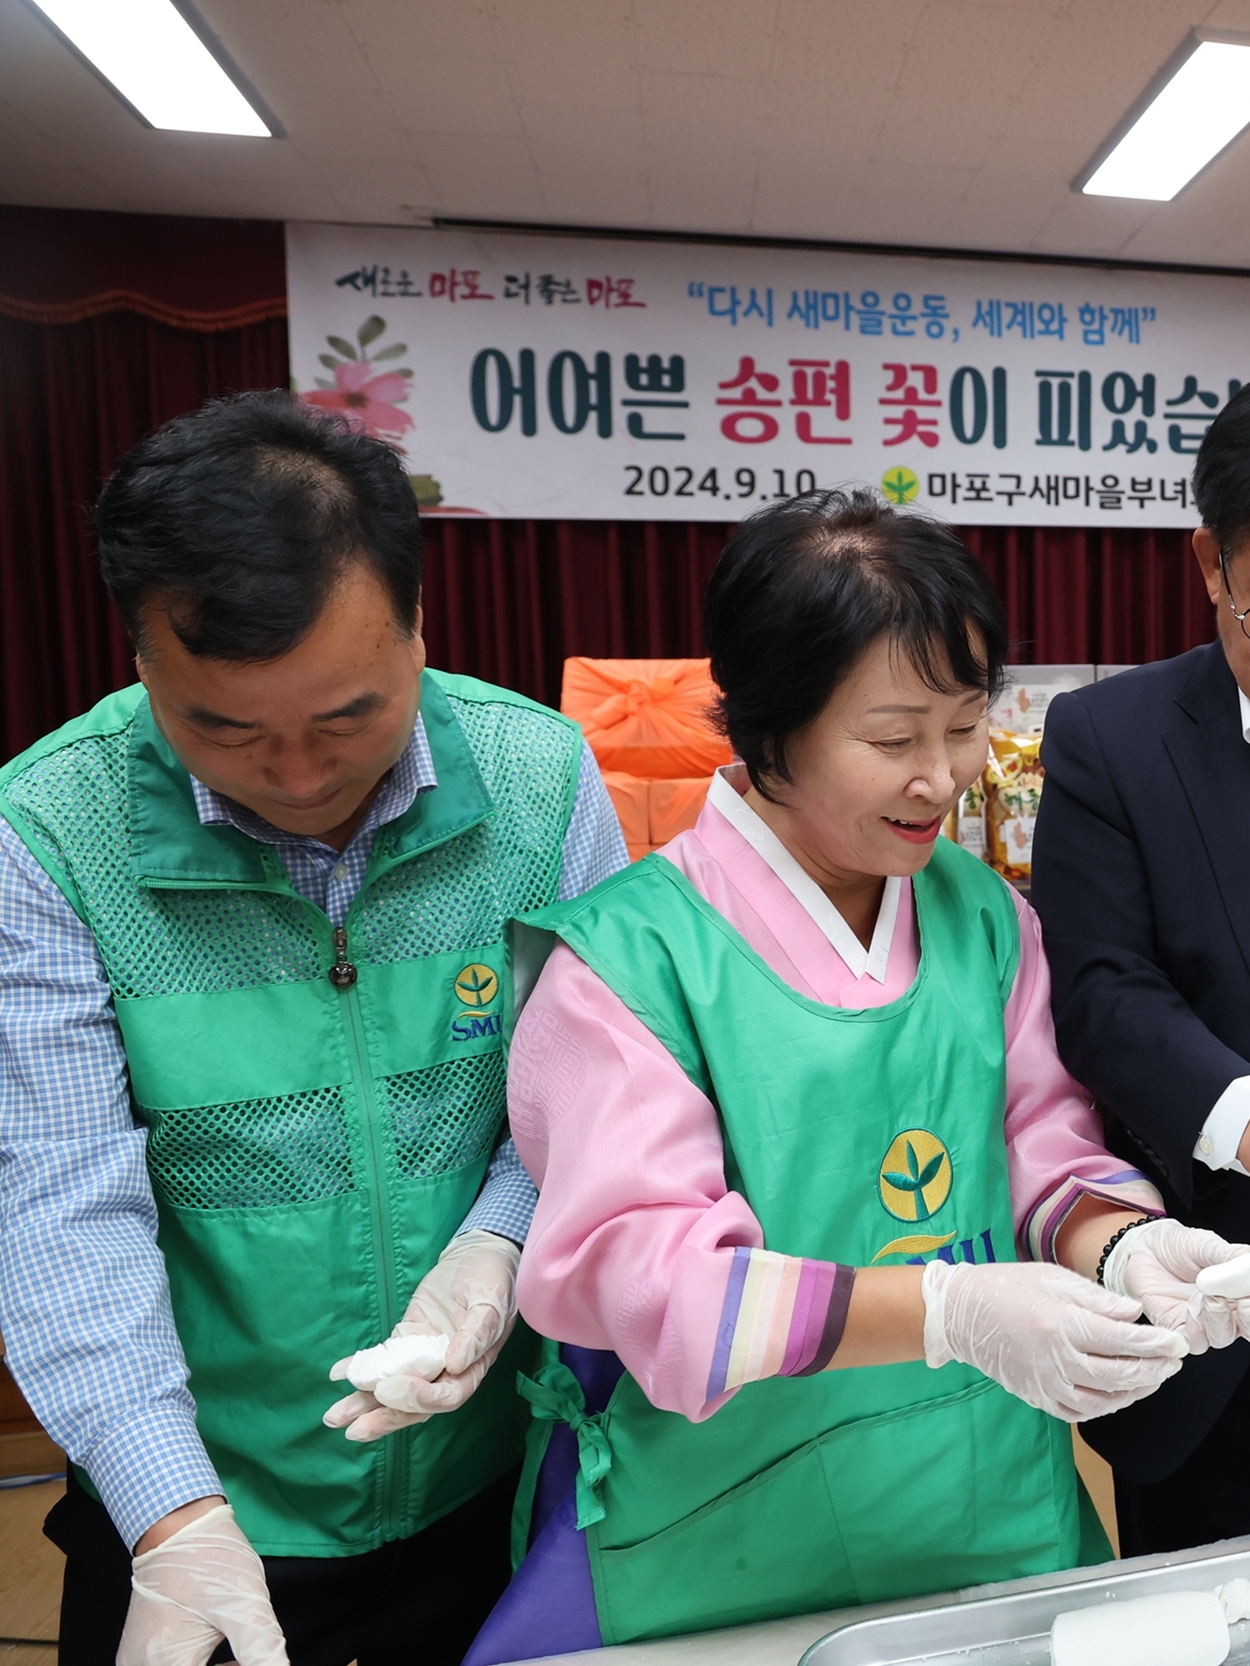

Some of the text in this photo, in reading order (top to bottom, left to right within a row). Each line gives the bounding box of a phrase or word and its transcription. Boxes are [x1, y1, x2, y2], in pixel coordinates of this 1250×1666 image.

[335, 264, 646, 309] 새로운 마포 더 좋은 마포
[786, 289, 960, 343] 새마을운동,
[971, 298, 1068, 341] 세계와
[470, 347, 1242, 454] 어여쁜 송편 꽃이 피었습
[624, 464, 816, 500] 2024.9.10
[927, 472, 1197, 510] 마포구새마을부녀
